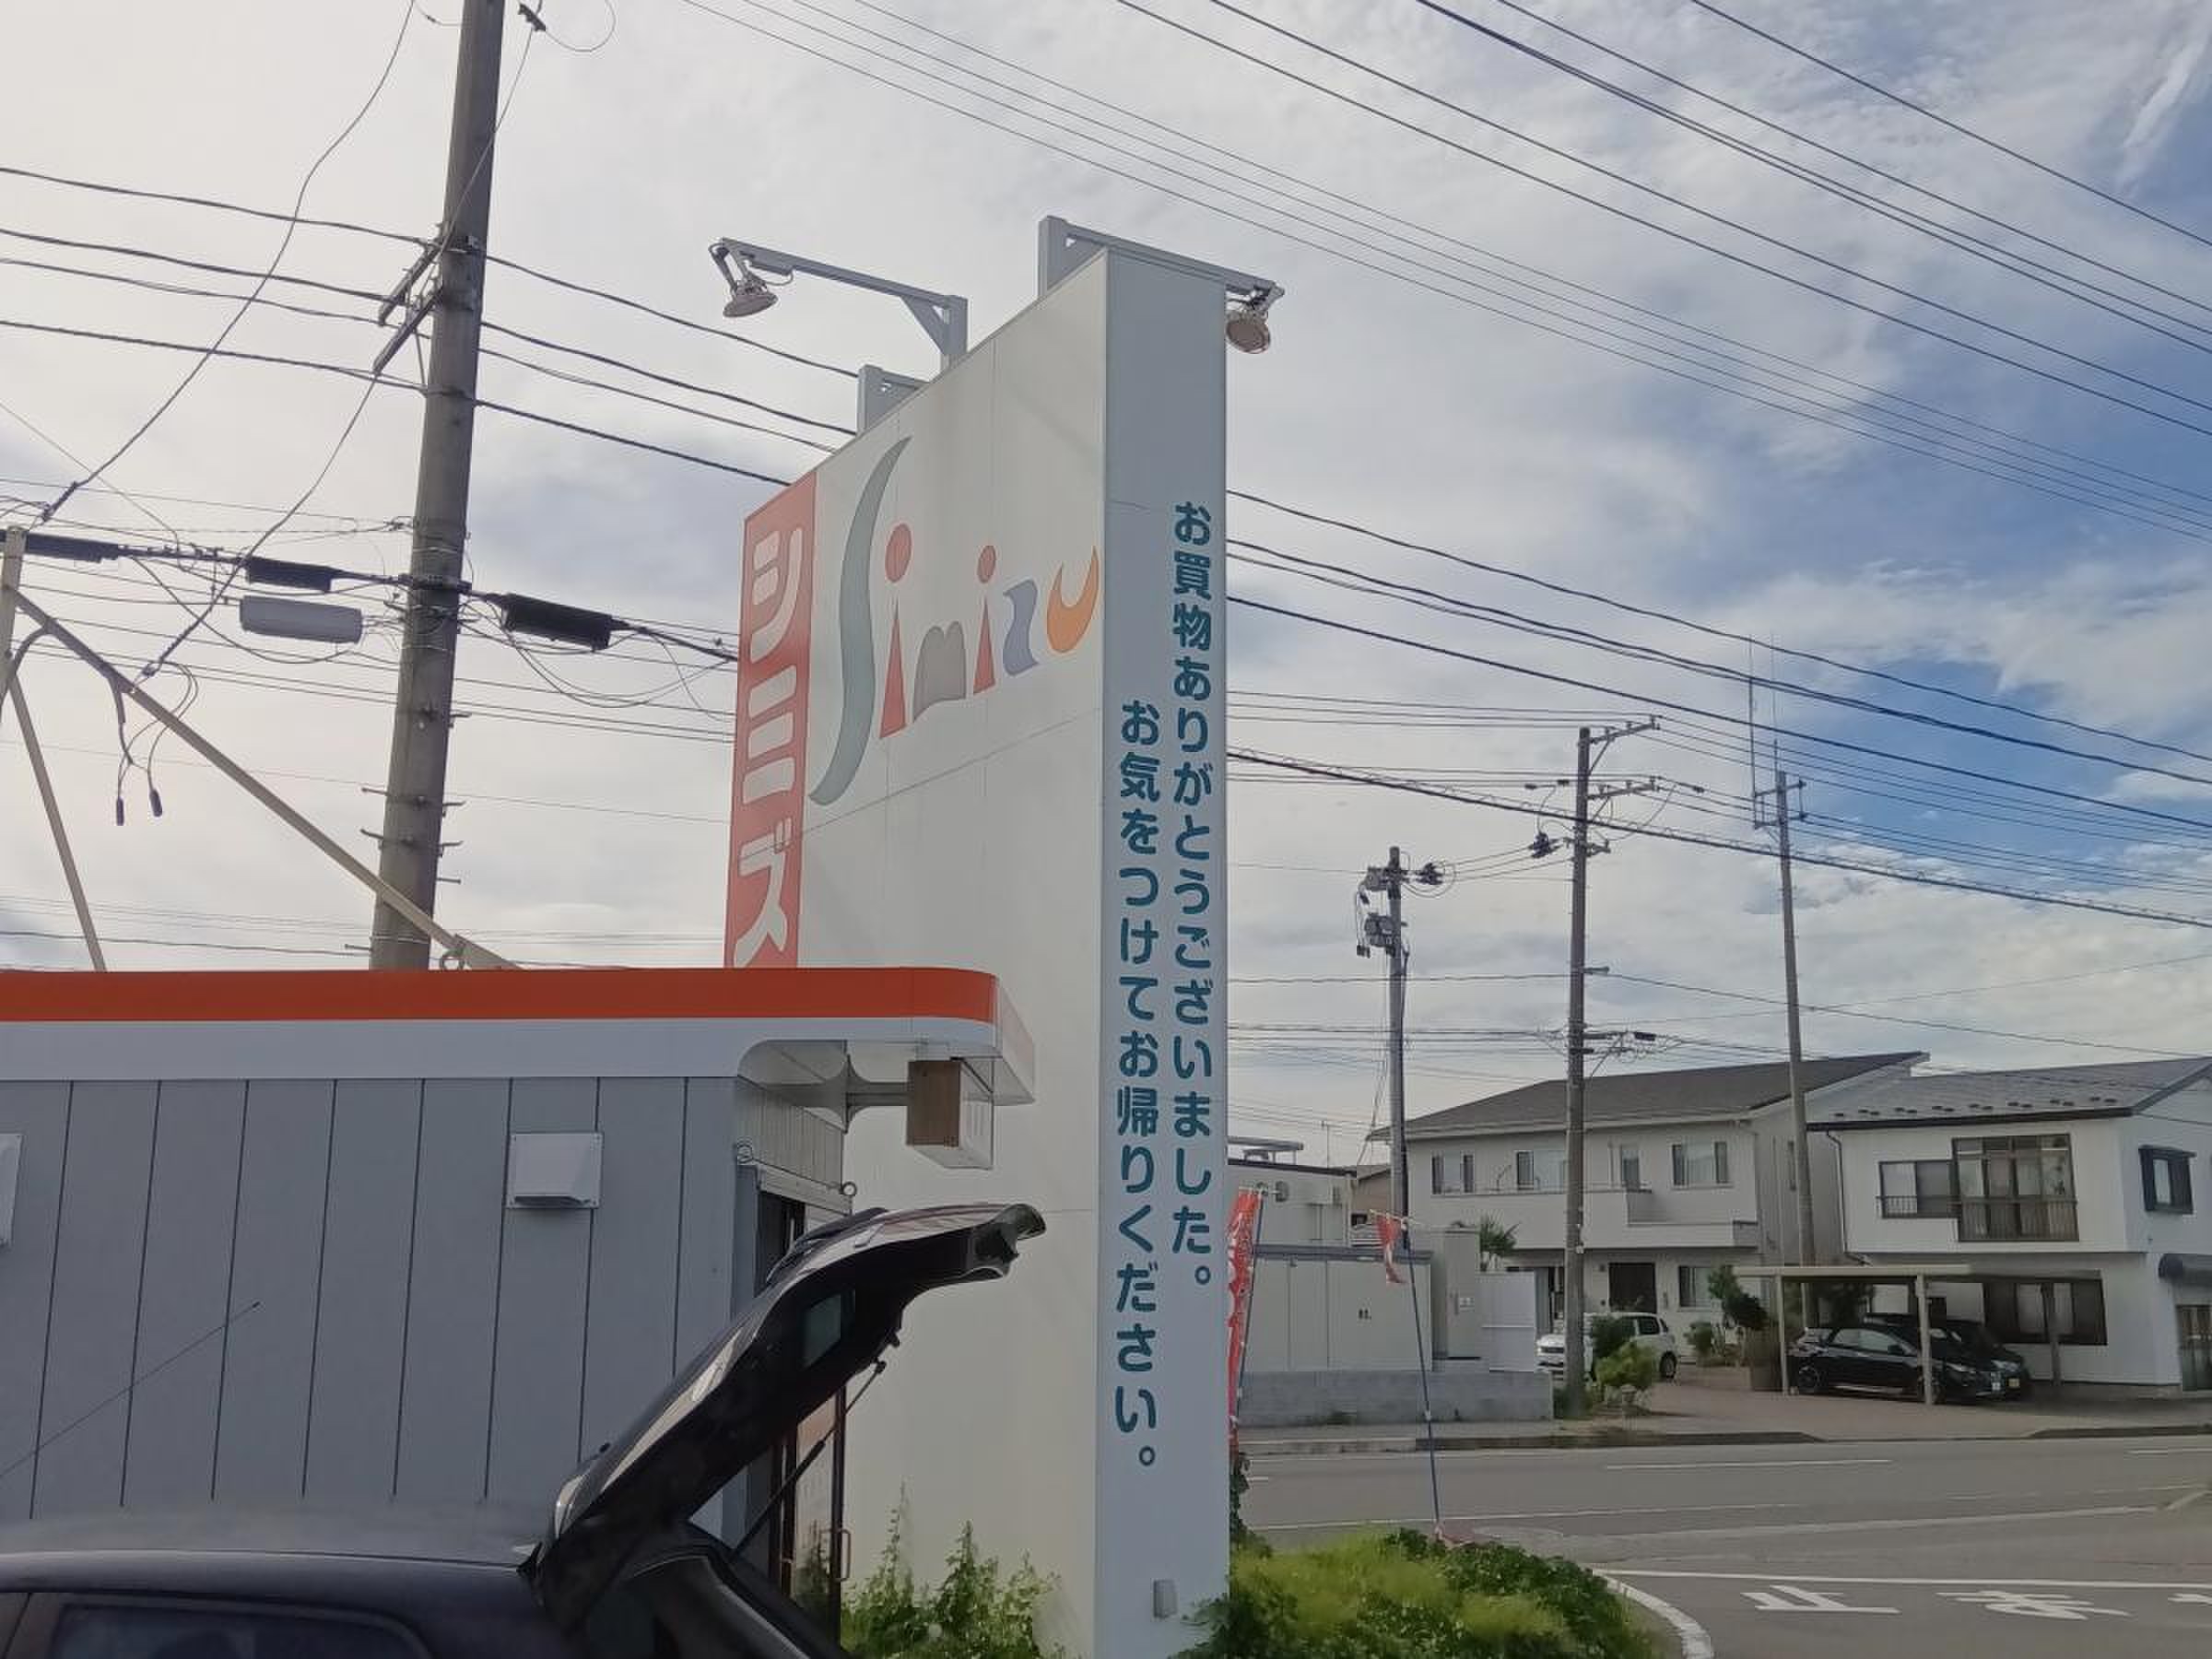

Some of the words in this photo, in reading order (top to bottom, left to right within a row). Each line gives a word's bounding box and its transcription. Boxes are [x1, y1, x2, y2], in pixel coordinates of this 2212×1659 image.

[734, 526, 803, 968] シミズ
[1172, 501, 1213, 1285] お買物ありがとうございました。
[1115, 700, 1159, 1465] お気をつけてお帰りください。
[1740, 1584, 2212, 1620] 止ま
